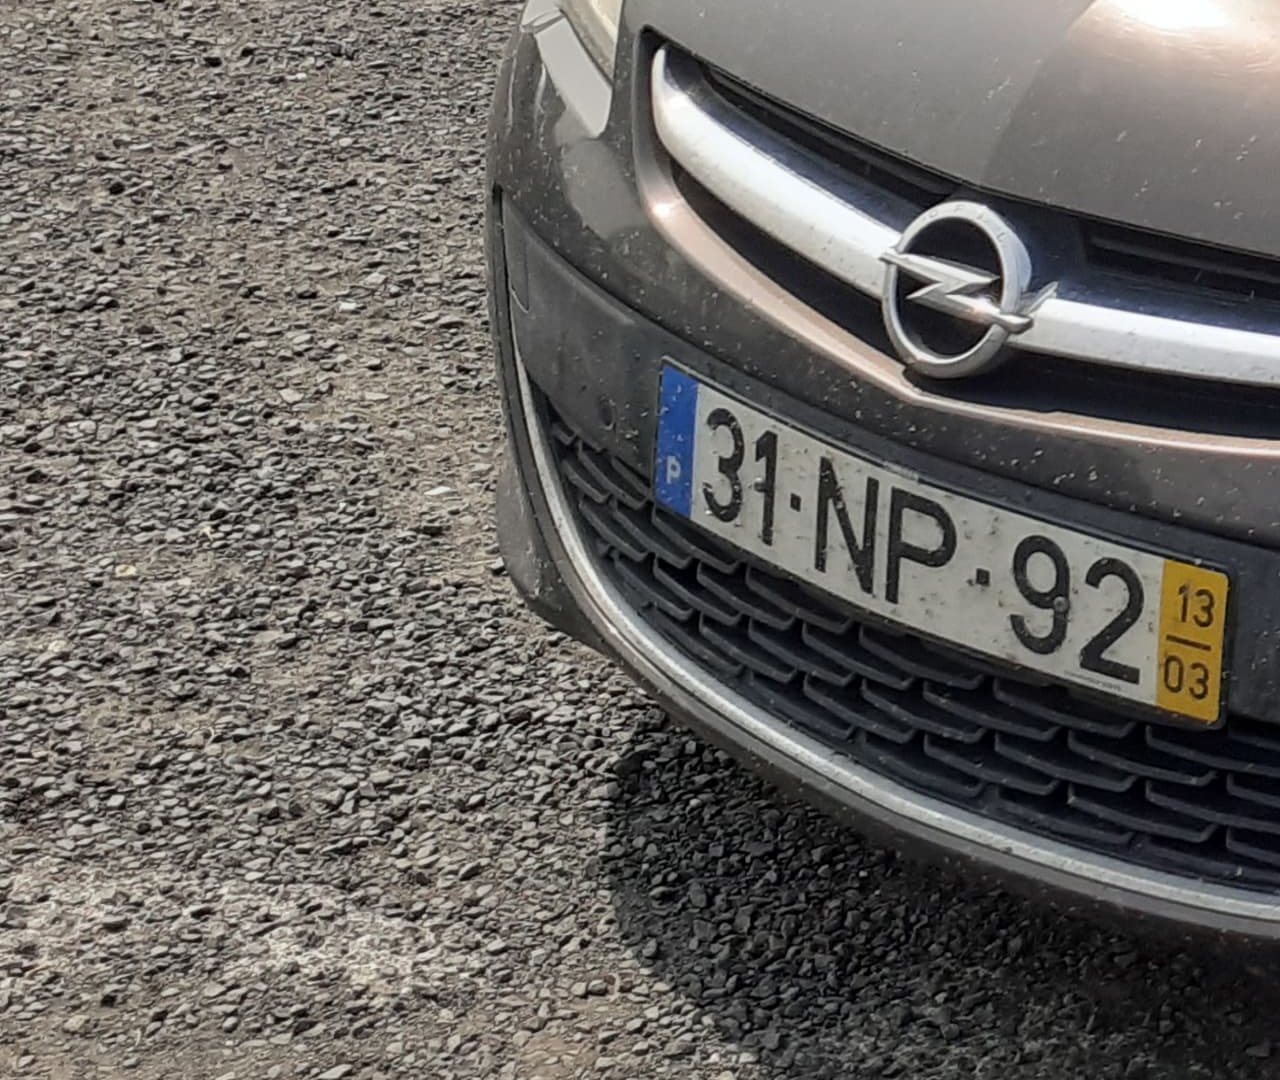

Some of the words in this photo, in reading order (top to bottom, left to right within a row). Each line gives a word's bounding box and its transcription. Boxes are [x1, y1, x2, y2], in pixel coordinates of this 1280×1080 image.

[667, 455, 682, 484] P
[1178, 582, 1216, 628] 13
[1163, 654, 1209, 701] 03
